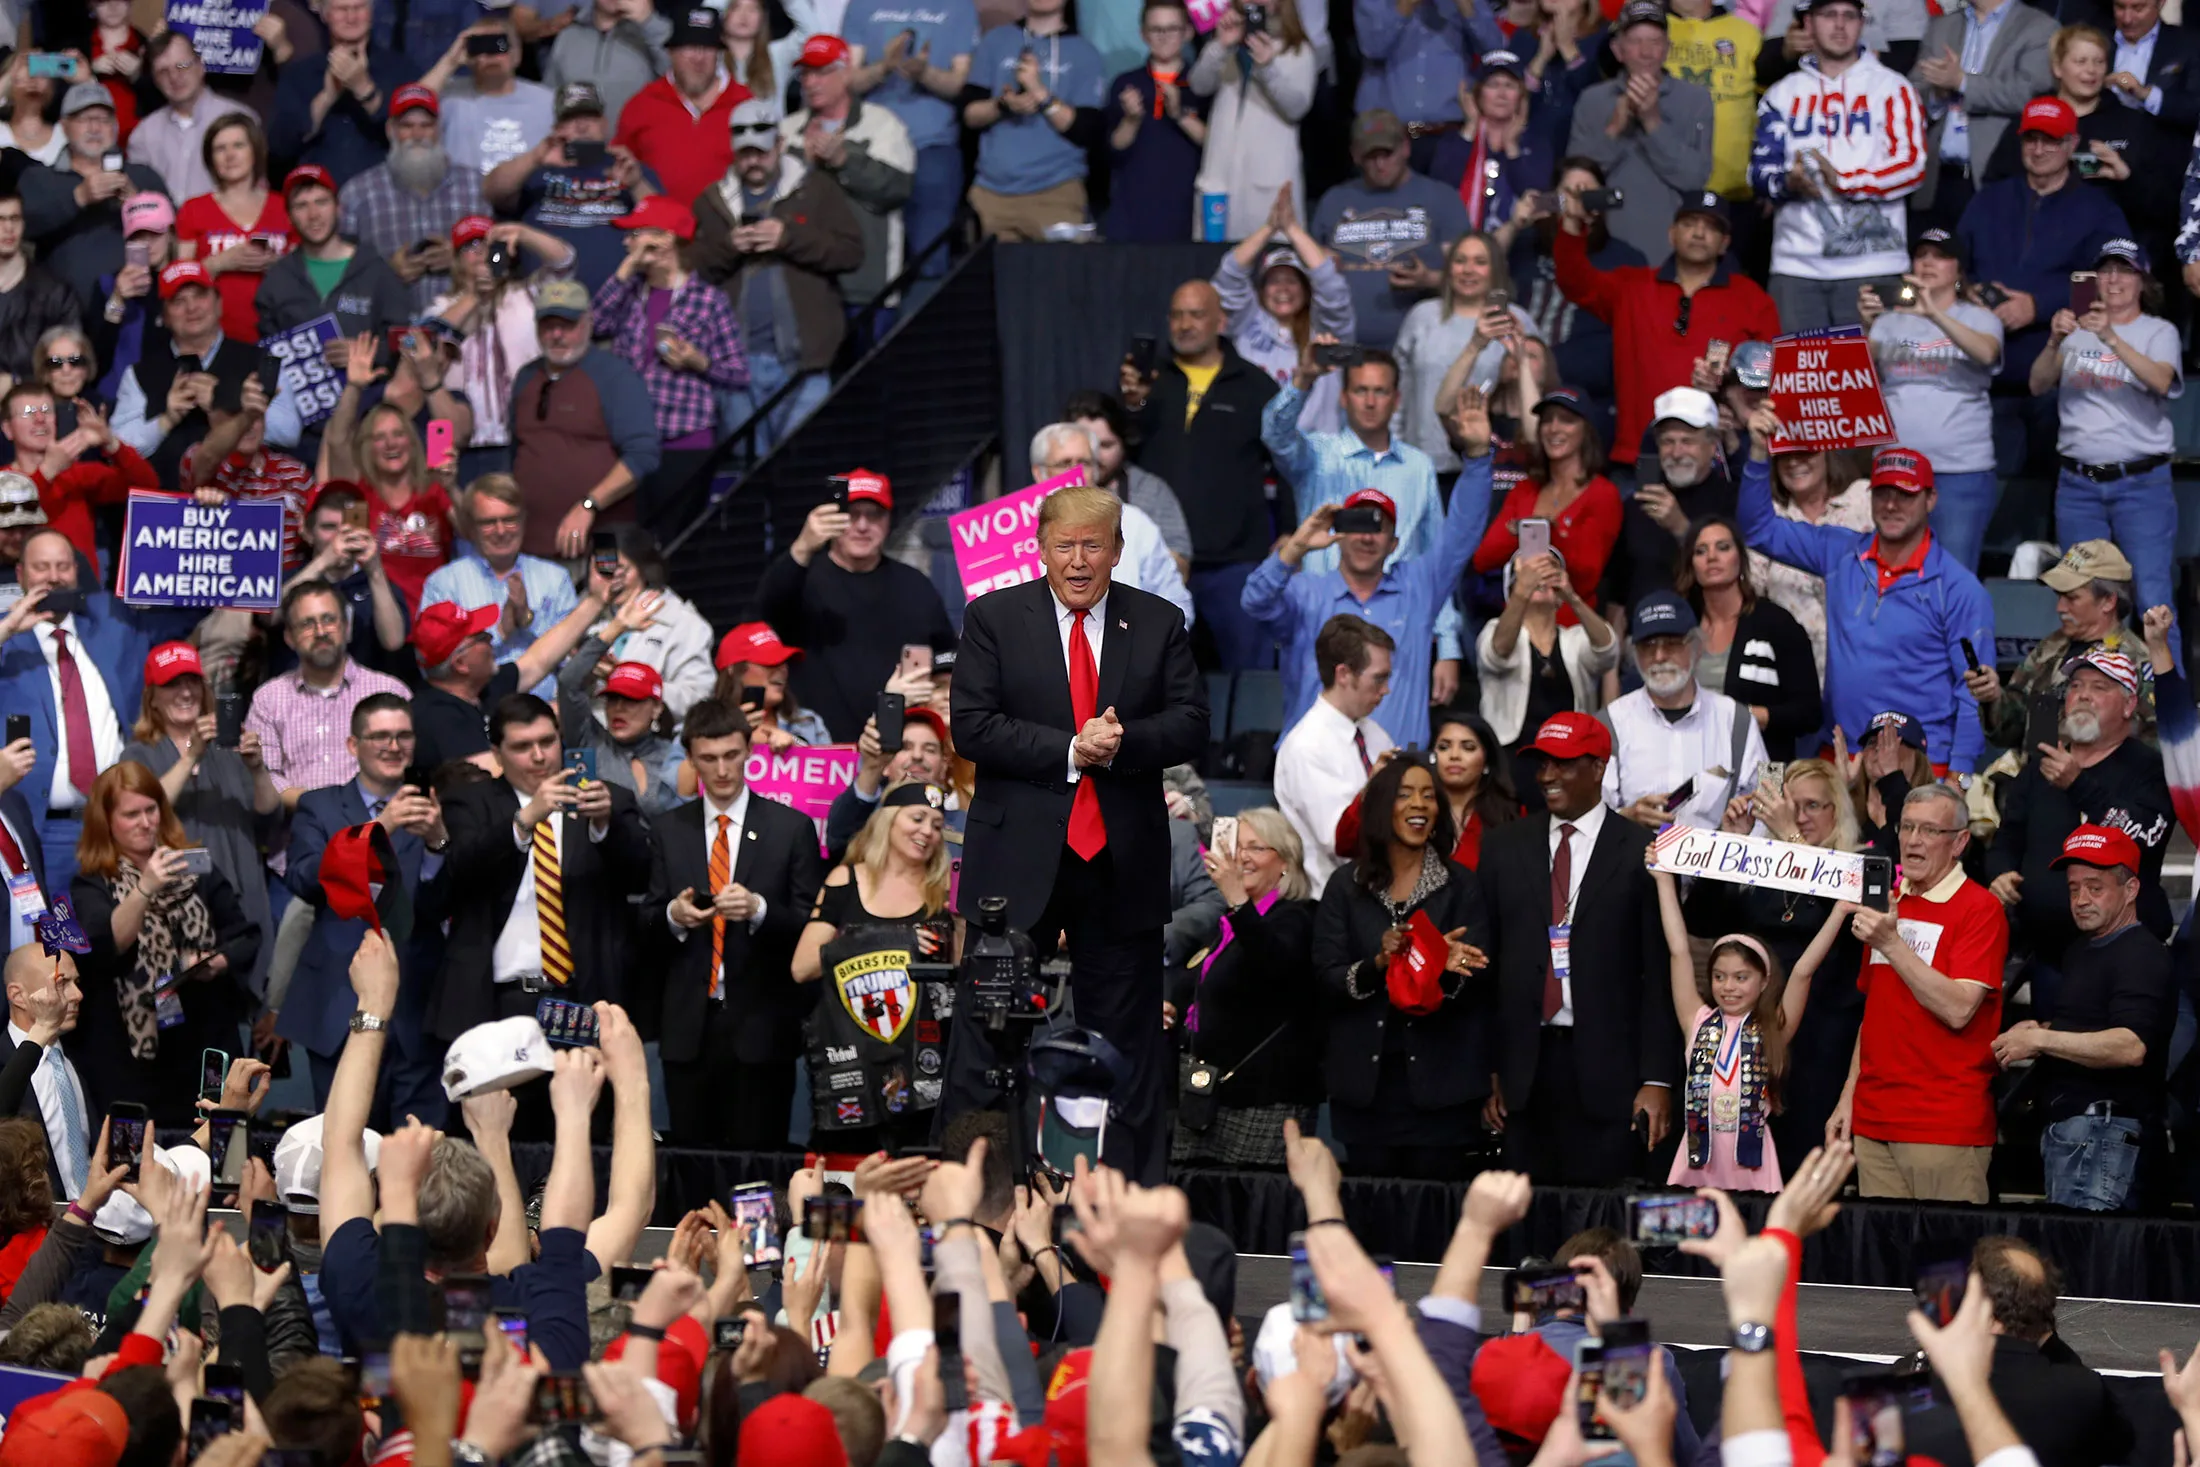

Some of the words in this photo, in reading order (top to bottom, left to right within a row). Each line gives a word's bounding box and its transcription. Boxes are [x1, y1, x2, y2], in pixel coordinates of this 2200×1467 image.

[167, 3, 263, 29] AMERICAN
[1789, 92, 1871, 138] USA
[1797, 349, 1829, 370] BUY
[1770, 368, 1875, 395] AMERICAN
[1798, 396, 1844, 418] HIRE
[1774, 414, 1889, 442] AMERICAN
[182, 506, 232, 528] BUY
[957, 477, 1084, 548] WOM
[134, 525, 277, 552] AMERICAN
[1012, 538, 1039, 559] FO
[177, 553, 233, 575] HIRE
[132, 572, 276, 598] AMERICAN
[744, 754, 855, 787] OMEN
[1674, 836, 1716, 869] God
[1718, 841, 1772, 879] Bless
[1810, 856, 1844, 889] Vets
[839, 955, 879, 979] BIKERS
[883, 954, 906, 965] FOR
[844, 969, 908, 998] TRUMP
